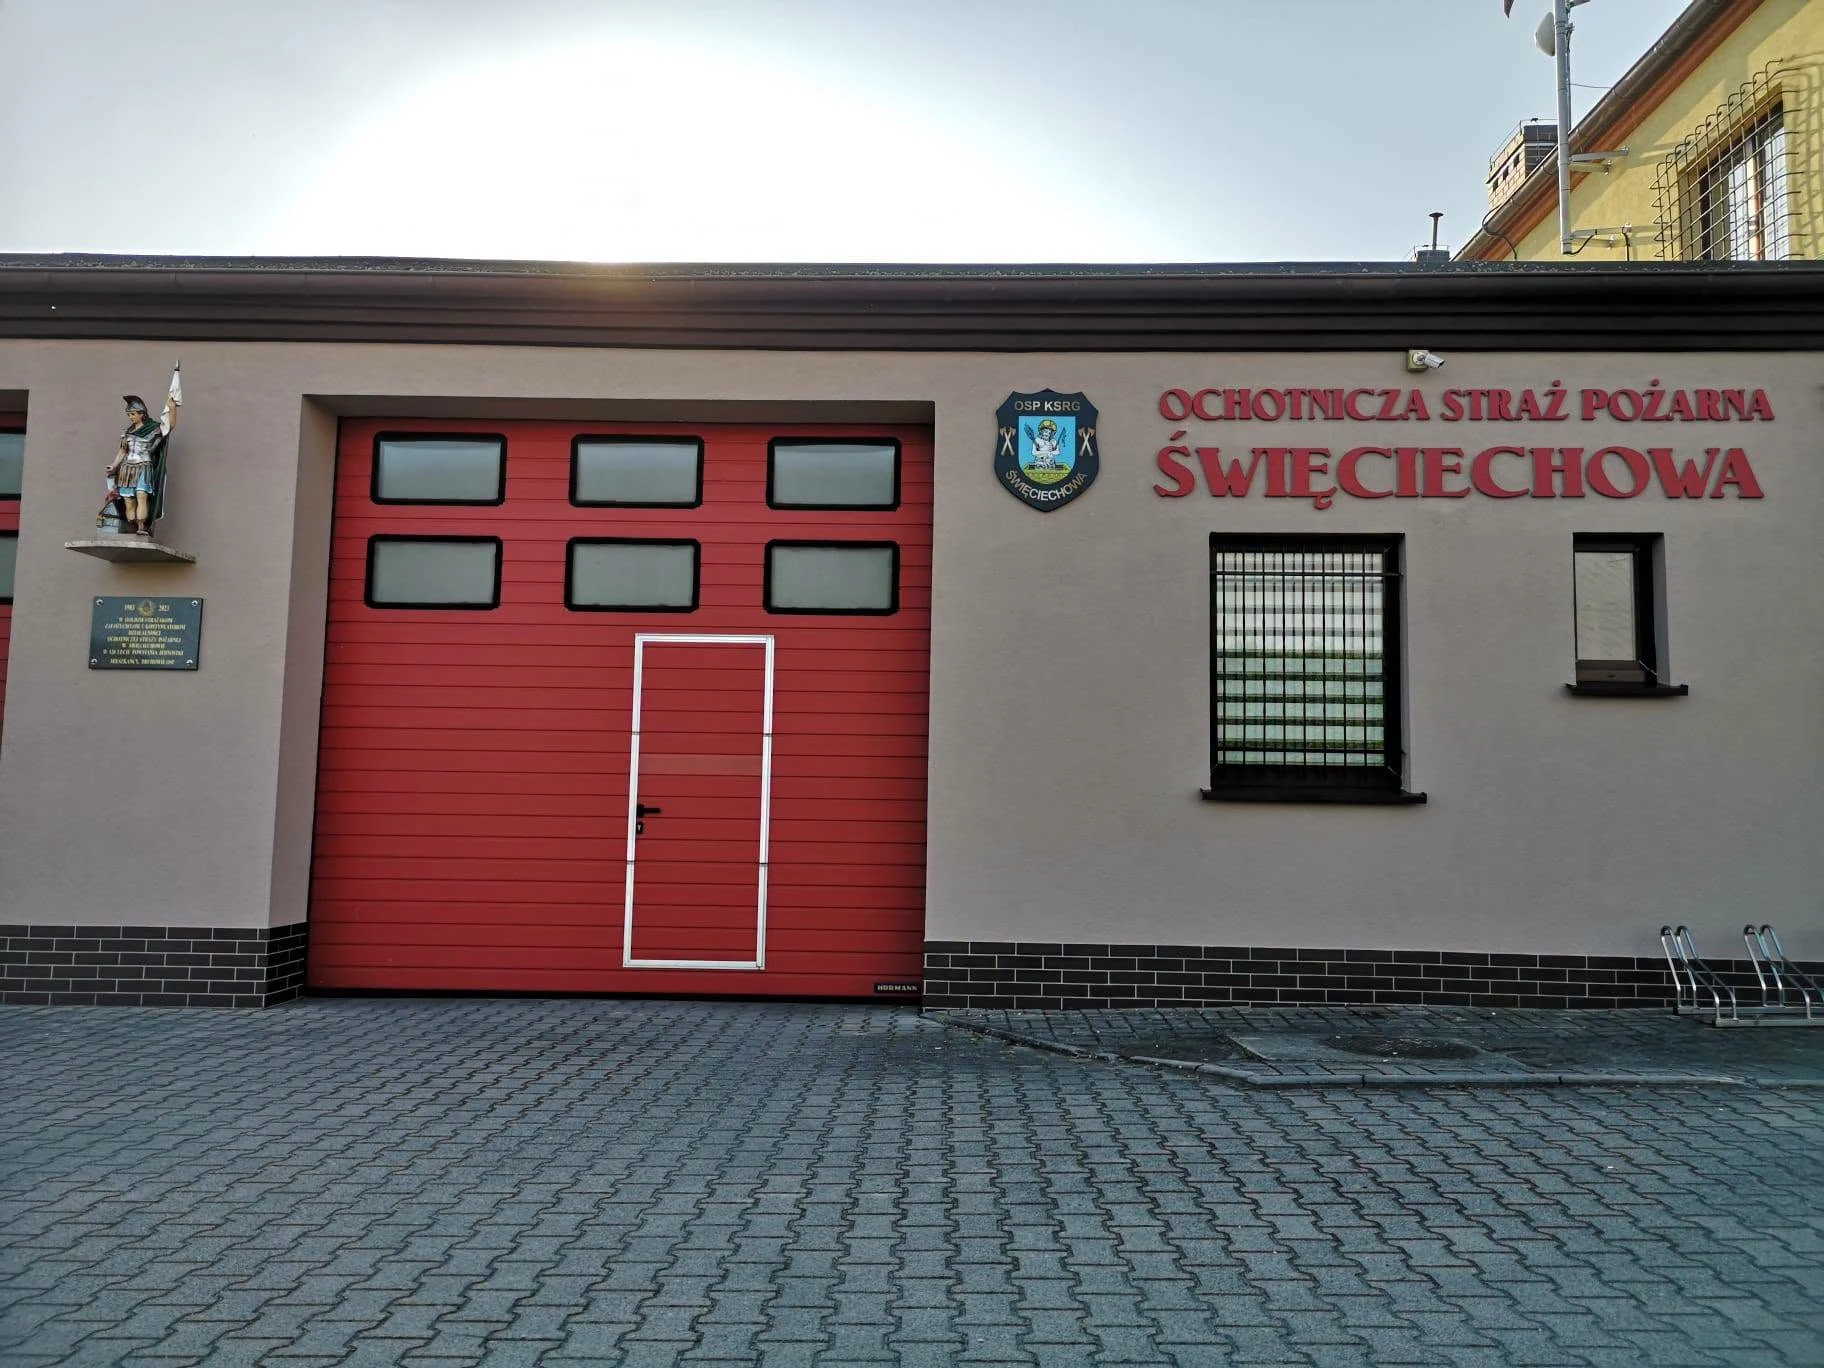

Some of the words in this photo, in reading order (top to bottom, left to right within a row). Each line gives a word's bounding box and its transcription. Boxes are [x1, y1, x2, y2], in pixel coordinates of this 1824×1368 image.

[1014, 400, 1040, 412] OSP
[1044, 400, 1081, 412] KSRG
[1159, 388, 1430, 421] OCHOTNICZA
[1440, 379, 1570, 421] STRAŻ
[1580, 378, 1775, 421] POŻARNA
[1005, 469, 1088, 501] ŚWIĘCIECHOWA
[1153, 430, 1765, 510] ŚWIĘCIECHOWA
